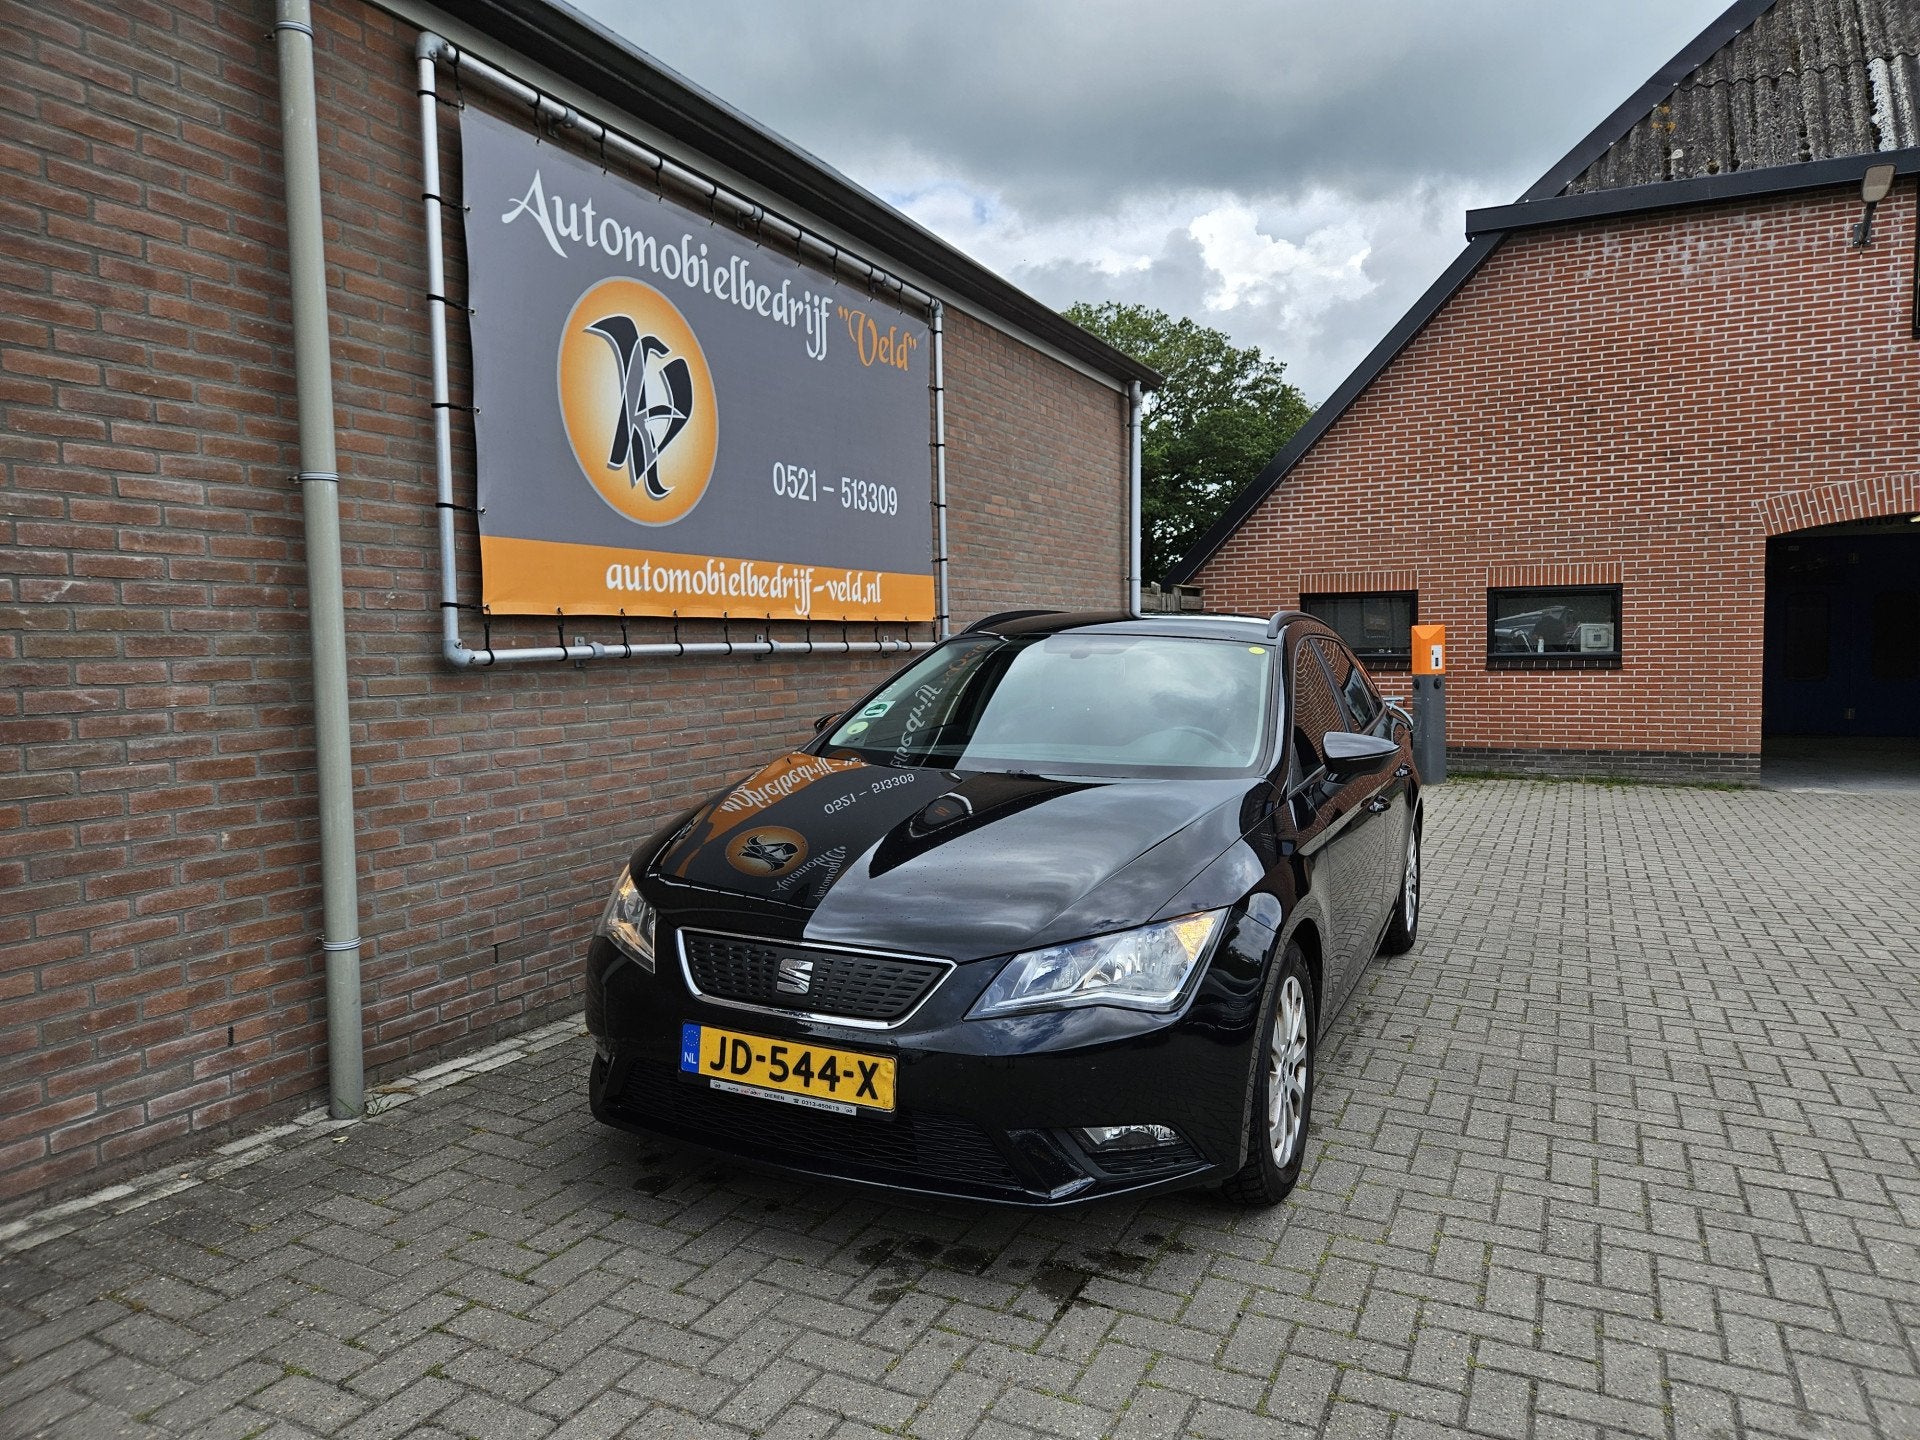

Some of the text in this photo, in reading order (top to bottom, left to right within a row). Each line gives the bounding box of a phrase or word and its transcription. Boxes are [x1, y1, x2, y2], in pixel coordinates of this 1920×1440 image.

[501, 169, 832, 361] Automobielbedrijf
[773, 461, 817, 502] 0521
[841, 477, 898, 516] 513309
[606, 559, 882, 616] automobielbedrijf-veld.nl
[684, 1052, 697, 1064] NL
[709, 1036, 879, 1100] JD-544-X
